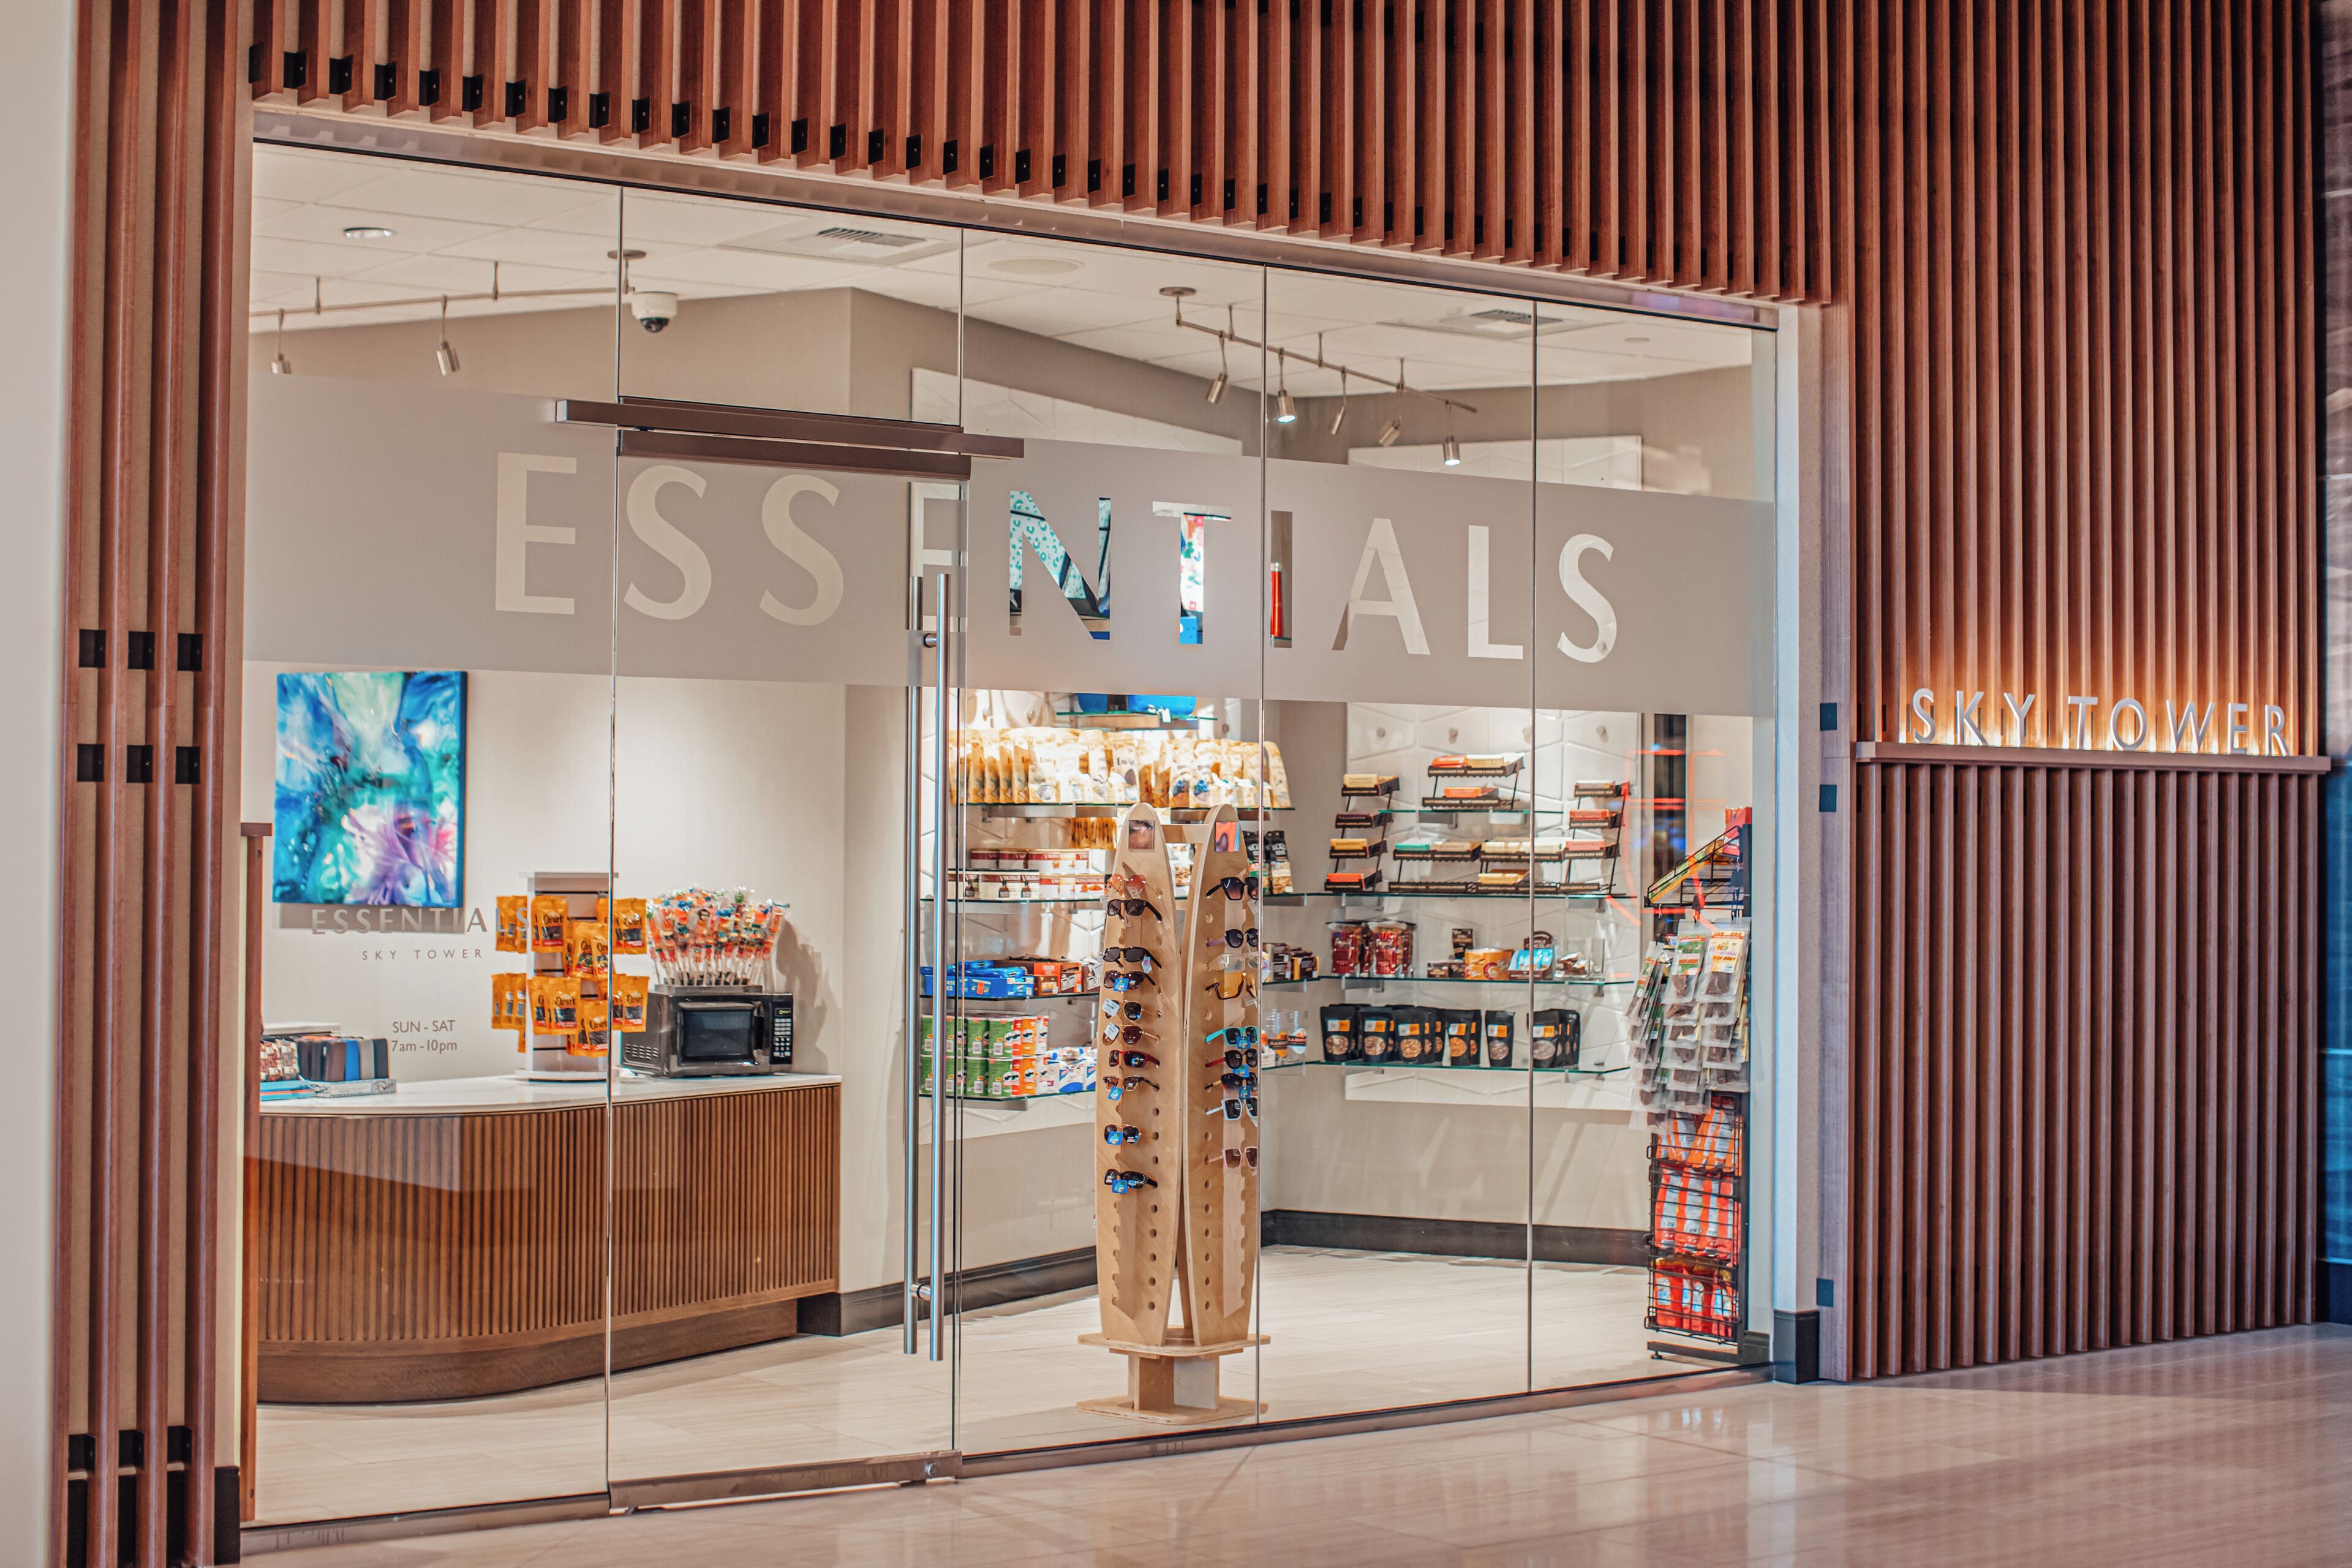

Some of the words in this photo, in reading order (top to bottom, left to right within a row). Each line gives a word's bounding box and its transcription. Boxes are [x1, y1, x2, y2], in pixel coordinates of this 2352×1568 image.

[495, 452, 1617, 663] ESSENTIALS
[1912, 688, 2035, 747] SKY
[2067, 696, 2289, 757] TOWER
[312, 907, 529, 935] ESSENTIALS
[363, 950, 397, 960] SKY
[415, 949, 482, 959] TOWER
[393, 1021, 421, 1033] SUN
[432, 1020, 456, 1033] SAT
[391, 1040, 417, 1052] 7am
